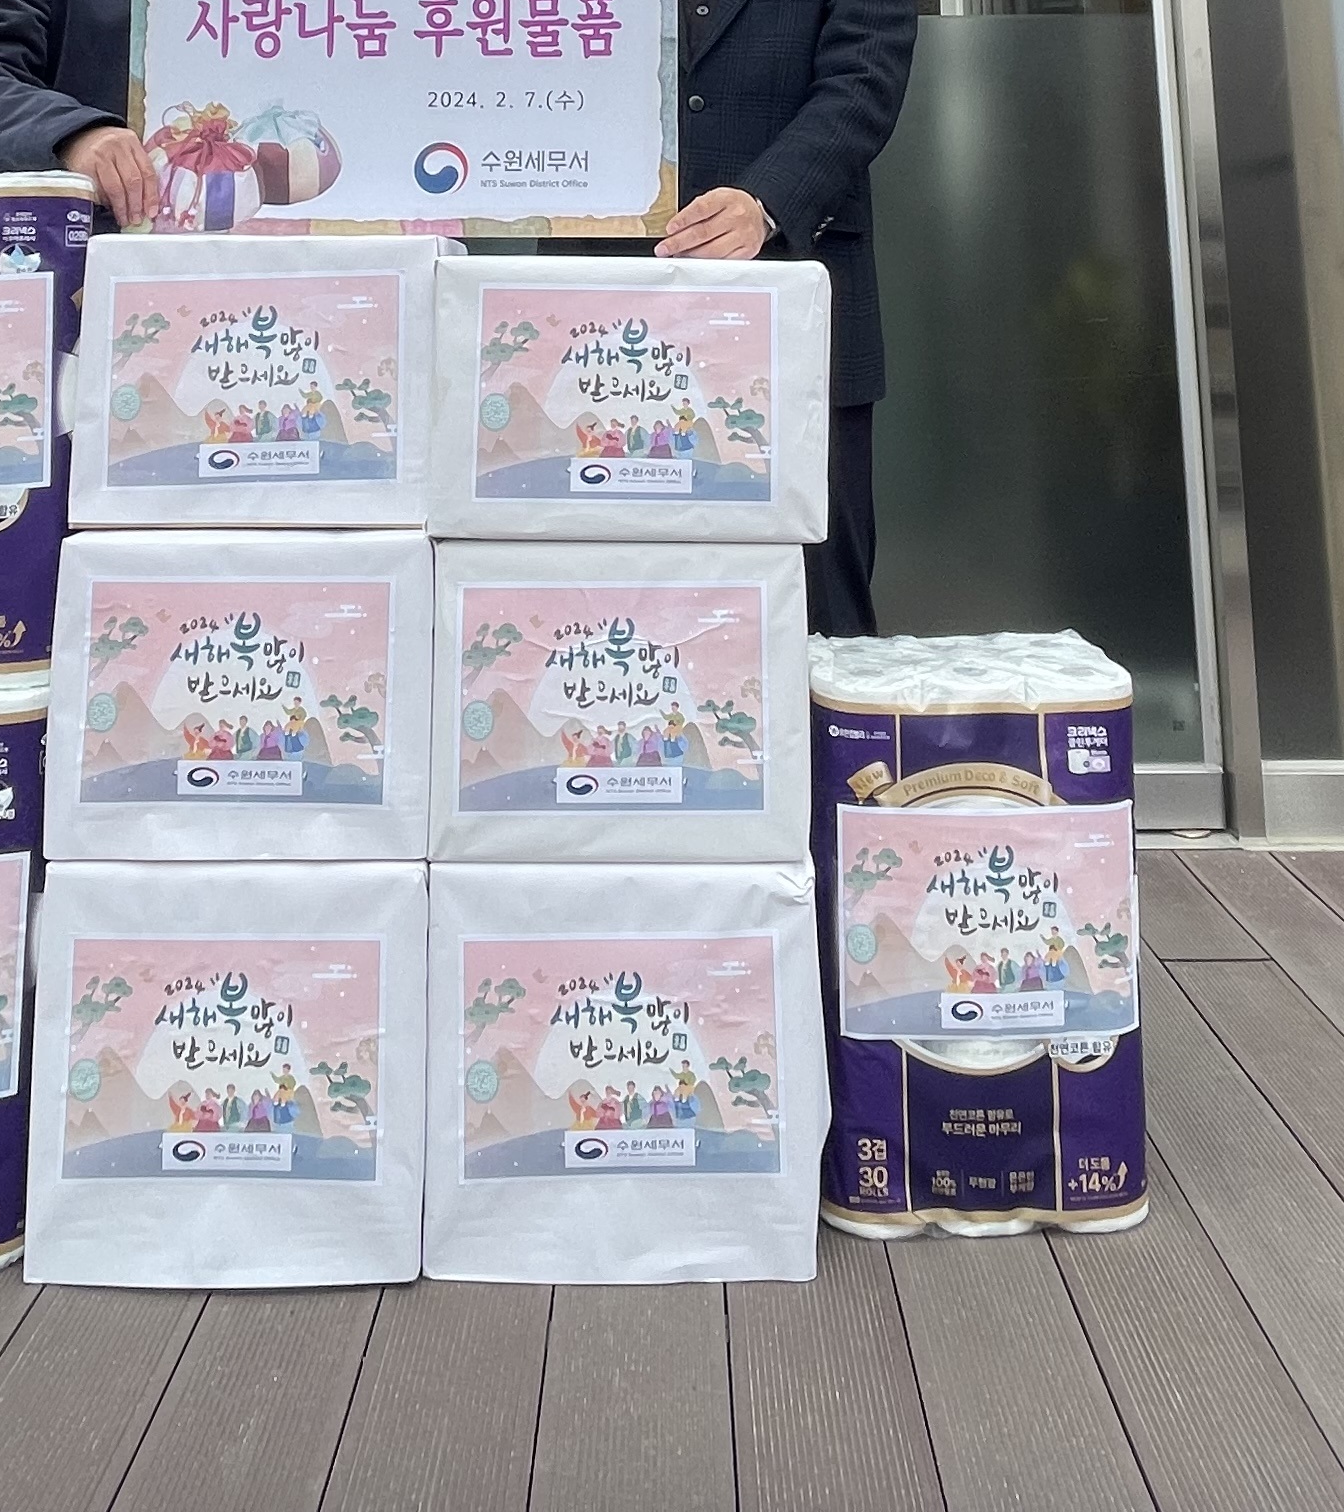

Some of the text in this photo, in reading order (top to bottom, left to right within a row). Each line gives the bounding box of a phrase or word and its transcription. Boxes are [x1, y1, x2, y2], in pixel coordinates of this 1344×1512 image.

[427, 90, 585, 111] 2024. 2. 7.(수)
[481, 150, 589, 173] 수원세무서
[480, 179, 588, 188] NTS Suwon District Office
[191, 305, 320, 362] 새해 복 많이
[561, 317, 691, 376] 새해 복 많이
[208, 361, 299, 390] 받으세요
[579, 373, 672, 402] 받으세요
[170, 611, 305, 674] 새해 복 많이
[545, 616, 680, 678] 새해 복 많이
[187, 671, 283, 703] 받으세요
[564, 677, 660, 709] 받으세요
[964, 769, 996, 782] Deco
[926, 845, 1059, 905] 새해 복 많이
[945, 904, 1040, 936] 받으세요
[155, 971, 294, 1038] 새해 복 많이
[550, 971, 690, 1036] 새해 복 많이
[173, 1036, 271, 1070] 받으세요
[570, 1035, 669, 1068] 받으세요
[857, 1138, 887, 1161] 3겹
[859, 1166, 889, 1188] 30
[1068, 1171, 1117, 1193] +14%
